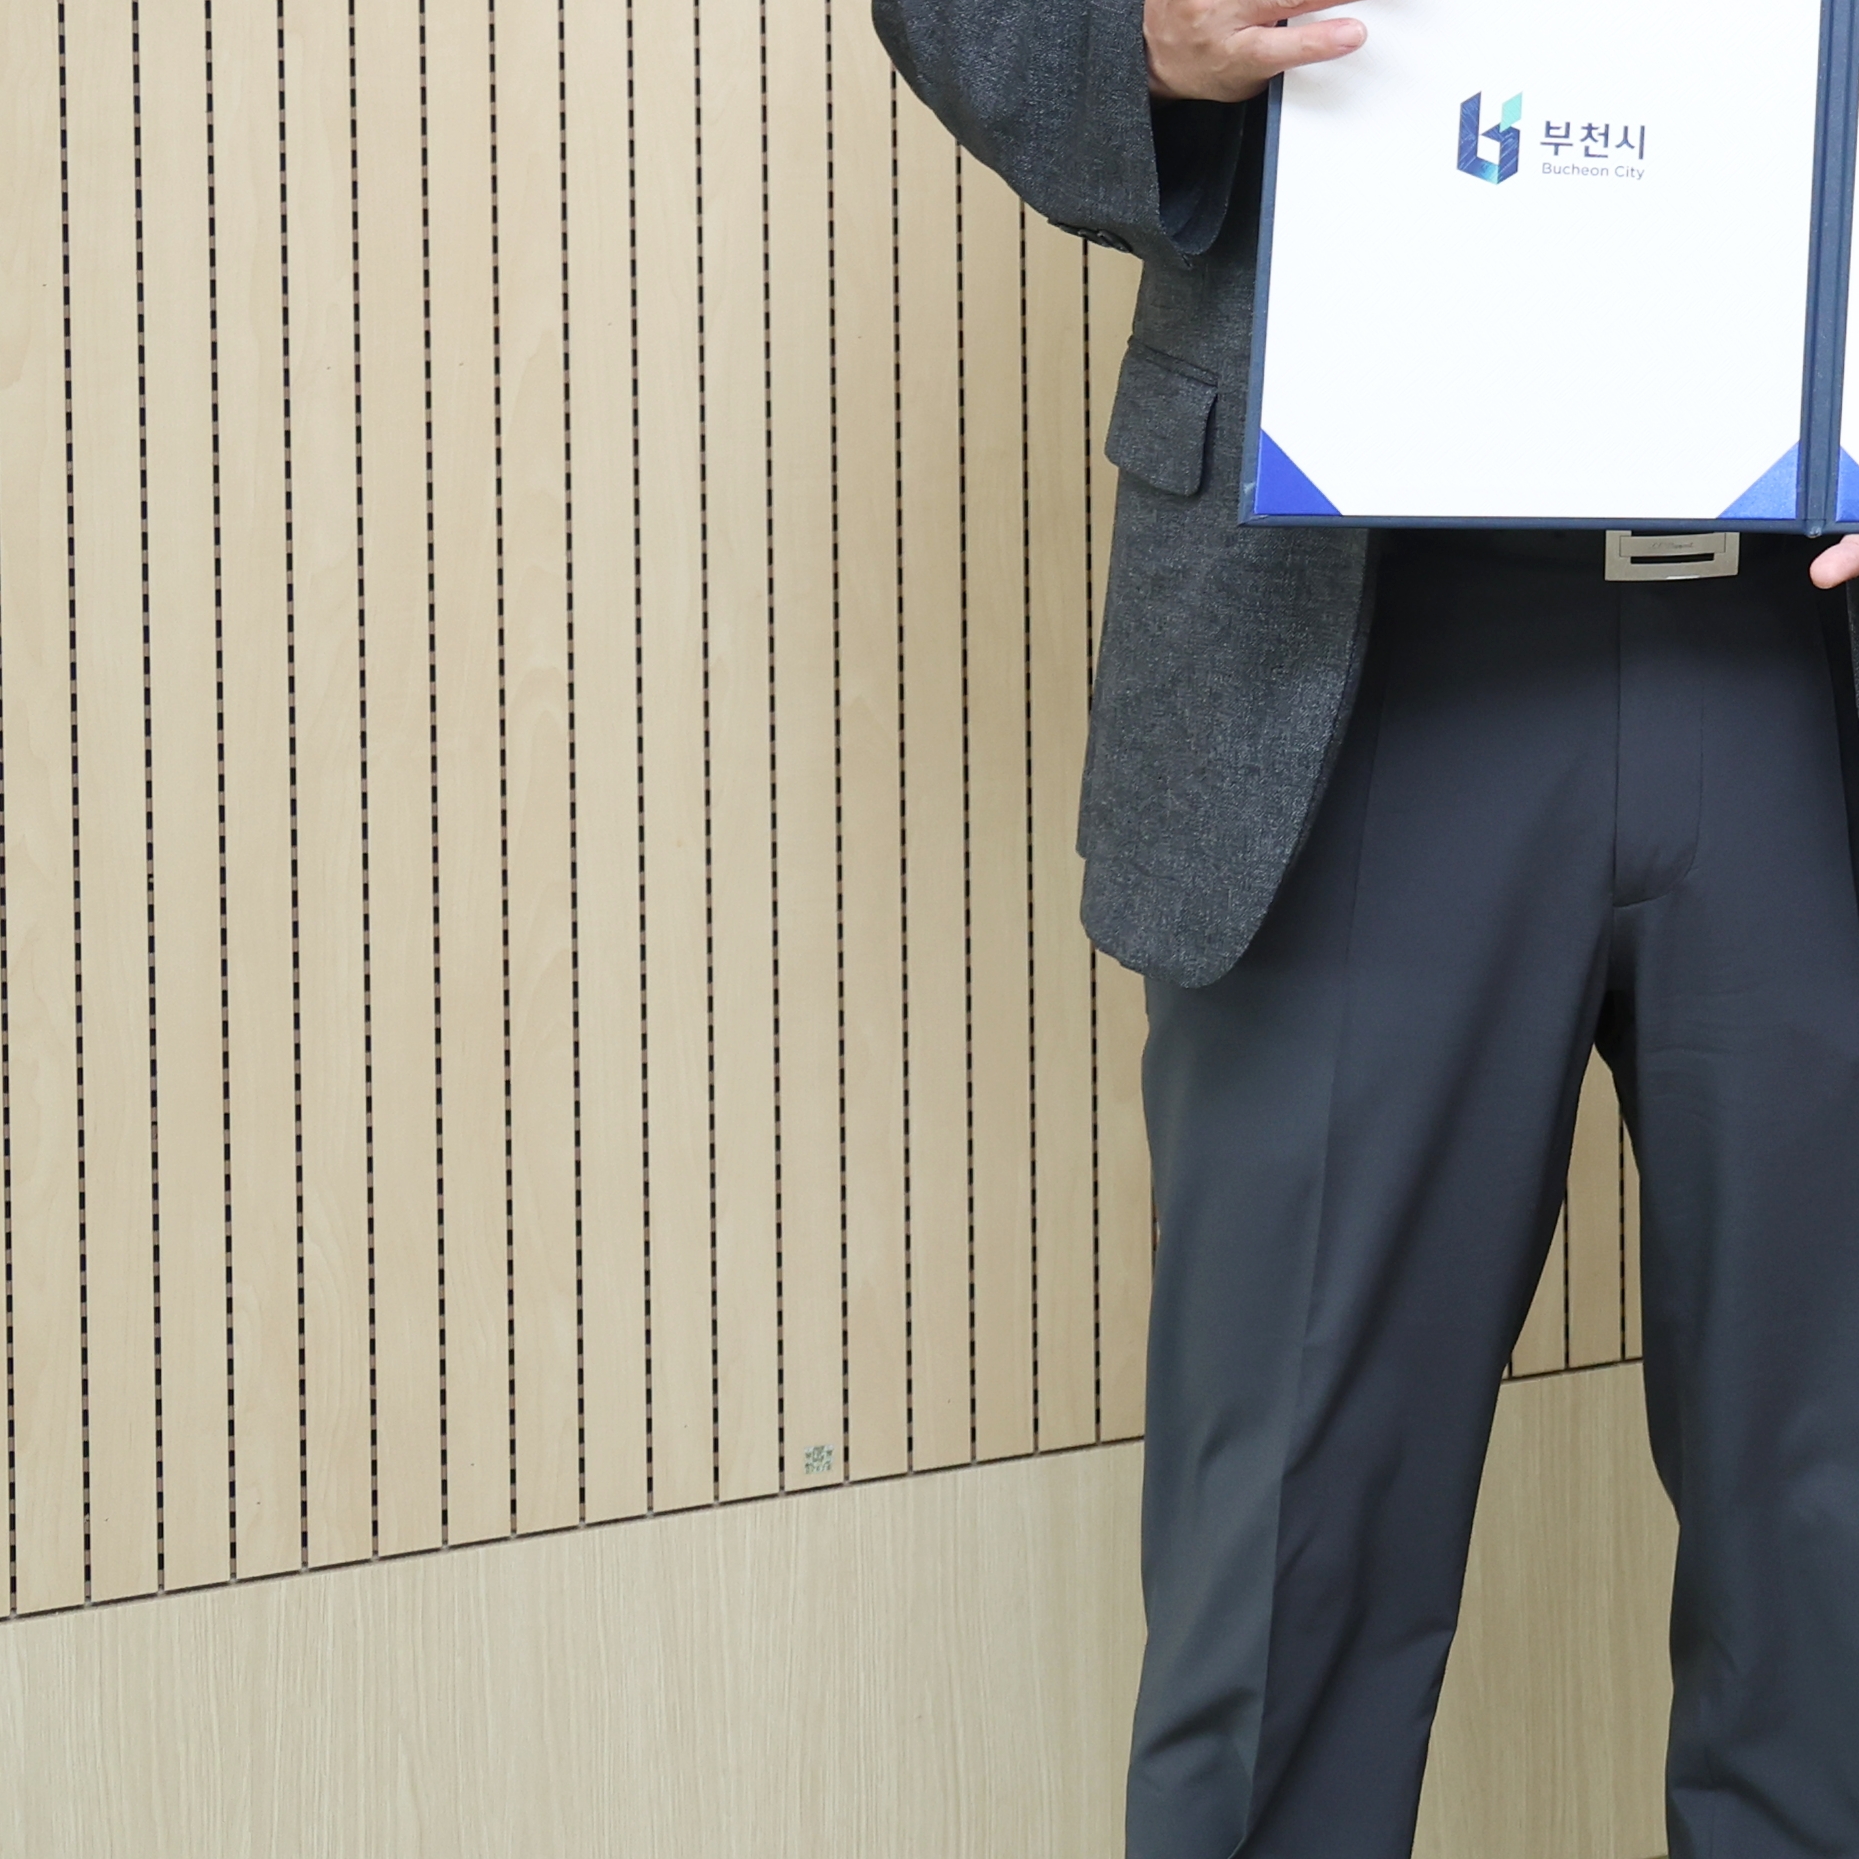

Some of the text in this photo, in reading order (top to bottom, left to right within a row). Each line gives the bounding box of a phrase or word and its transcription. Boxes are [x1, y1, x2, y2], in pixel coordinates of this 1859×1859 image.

[1538, 119, 1646, 161] 부천시
[1541, 162, 1646, 181] Bucheon City
